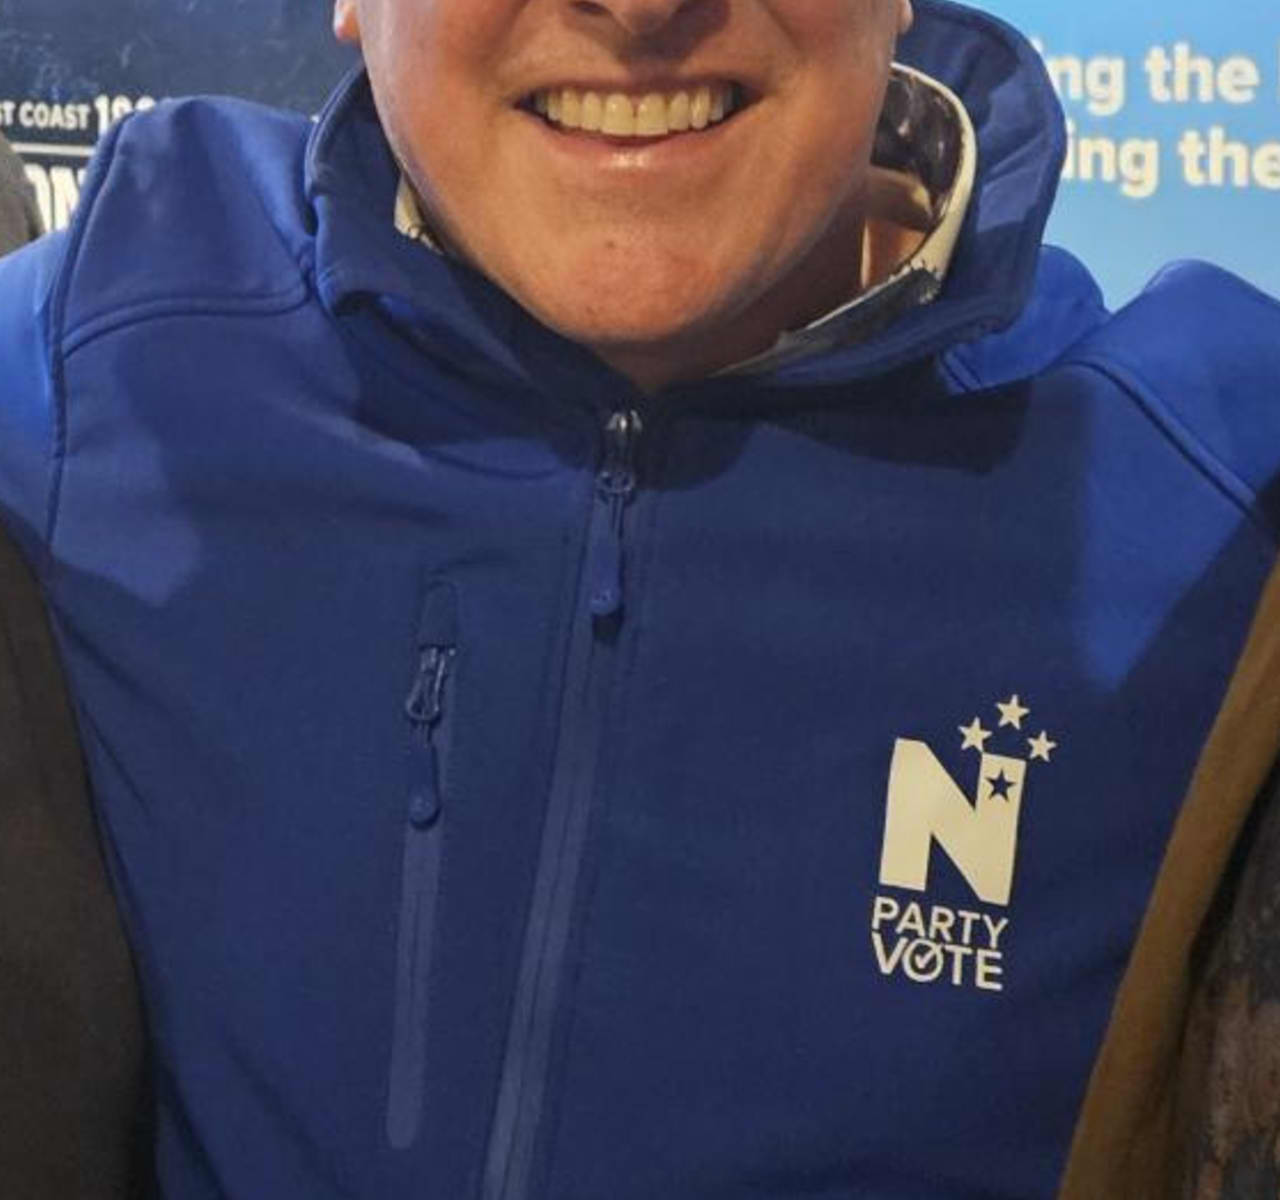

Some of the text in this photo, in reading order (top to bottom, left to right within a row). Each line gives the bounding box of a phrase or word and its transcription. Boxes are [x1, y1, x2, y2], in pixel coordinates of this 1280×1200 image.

[1144, 41, 1260, 104] the
[18, 101, 91, 131] COAST
[878, 735, 1028, 908] N
[871, 895, 1009, 950] PARTY
[871, 931, 1004, 992] VOTE
